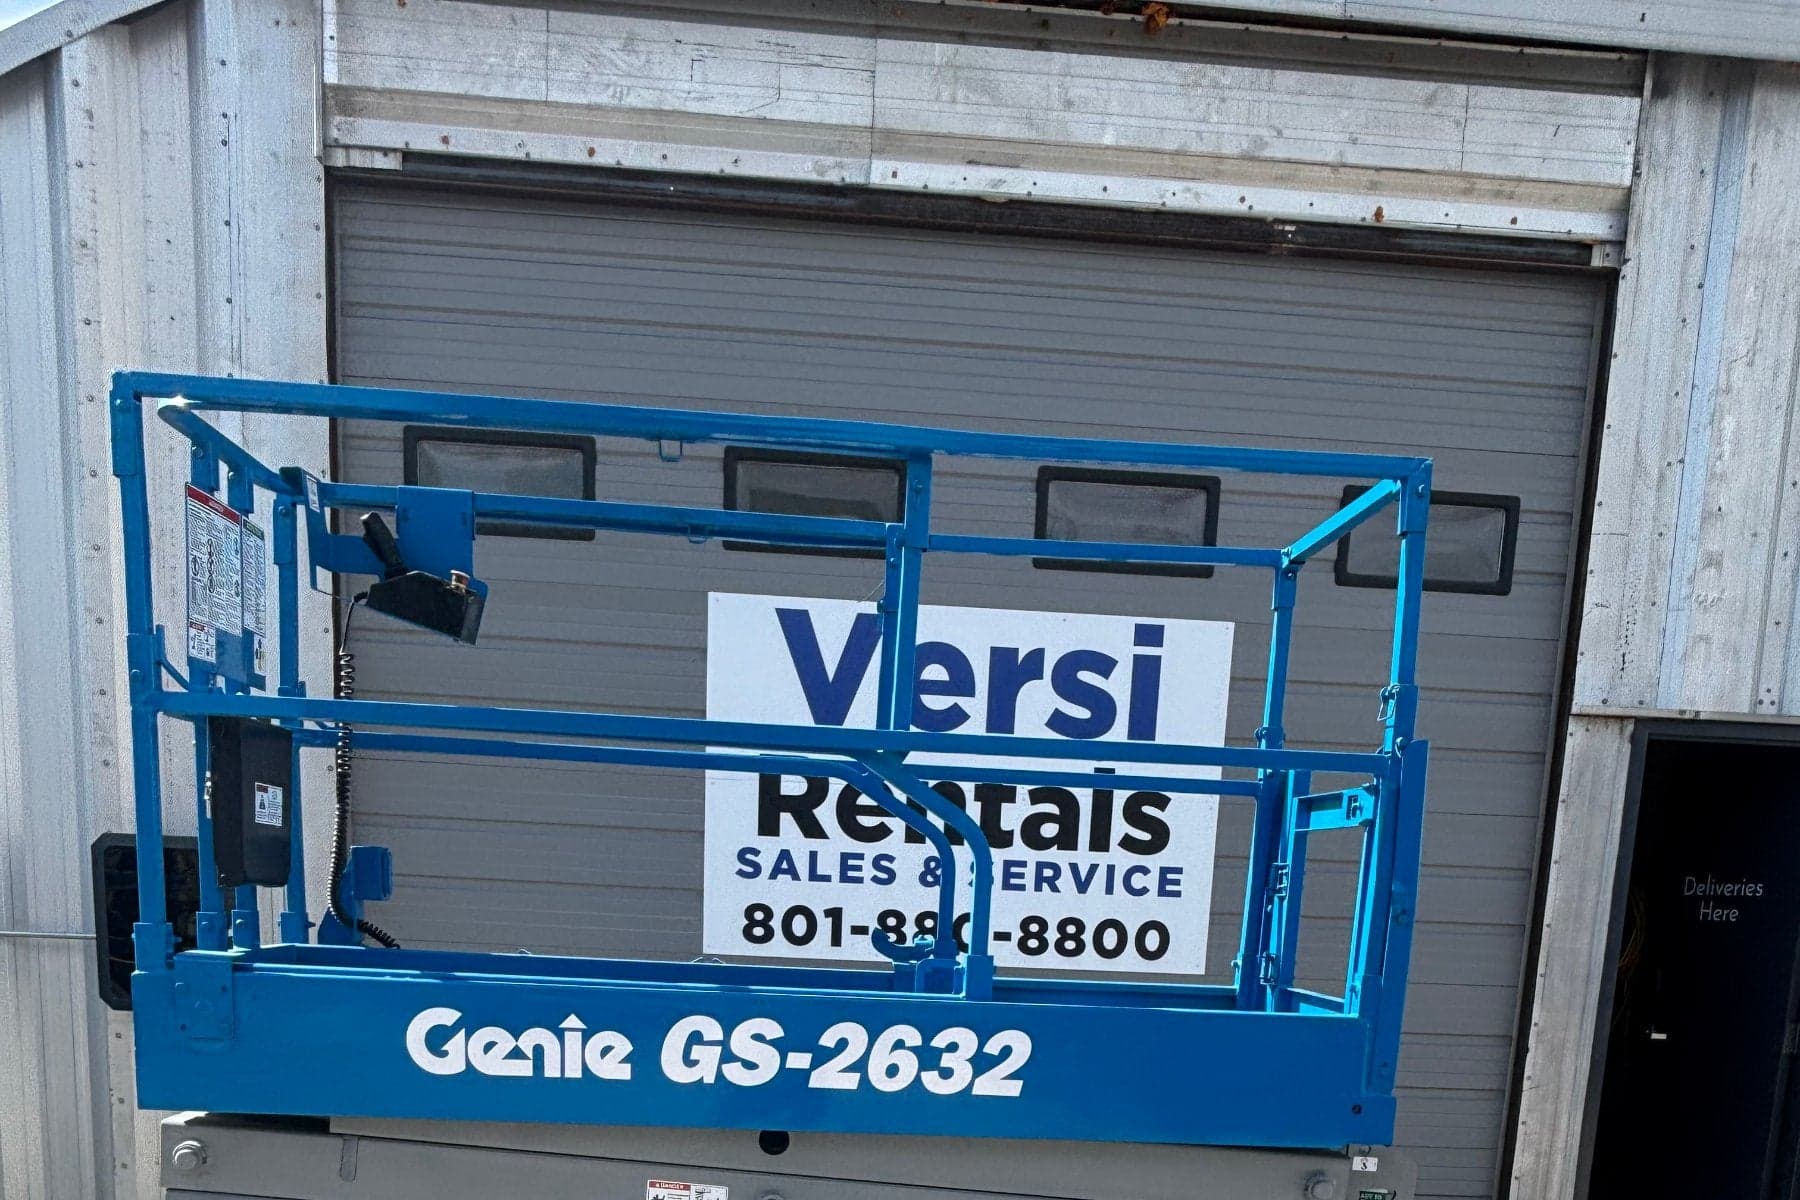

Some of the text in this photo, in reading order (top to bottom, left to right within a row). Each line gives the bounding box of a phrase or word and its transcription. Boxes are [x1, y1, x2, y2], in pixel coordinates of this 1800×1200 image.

[775, 607, 1165, 741] Versi
[757, 768, 1172, 856] Rentals
[735, 846, 897, 886] SALES
[918, 855, 942, 888] &
[1683, 873, 1765, 896] Deliveries
[1699, 900, 1739, 922] Here
[406, 1006, 1033, 1097] Genie GS-2632
